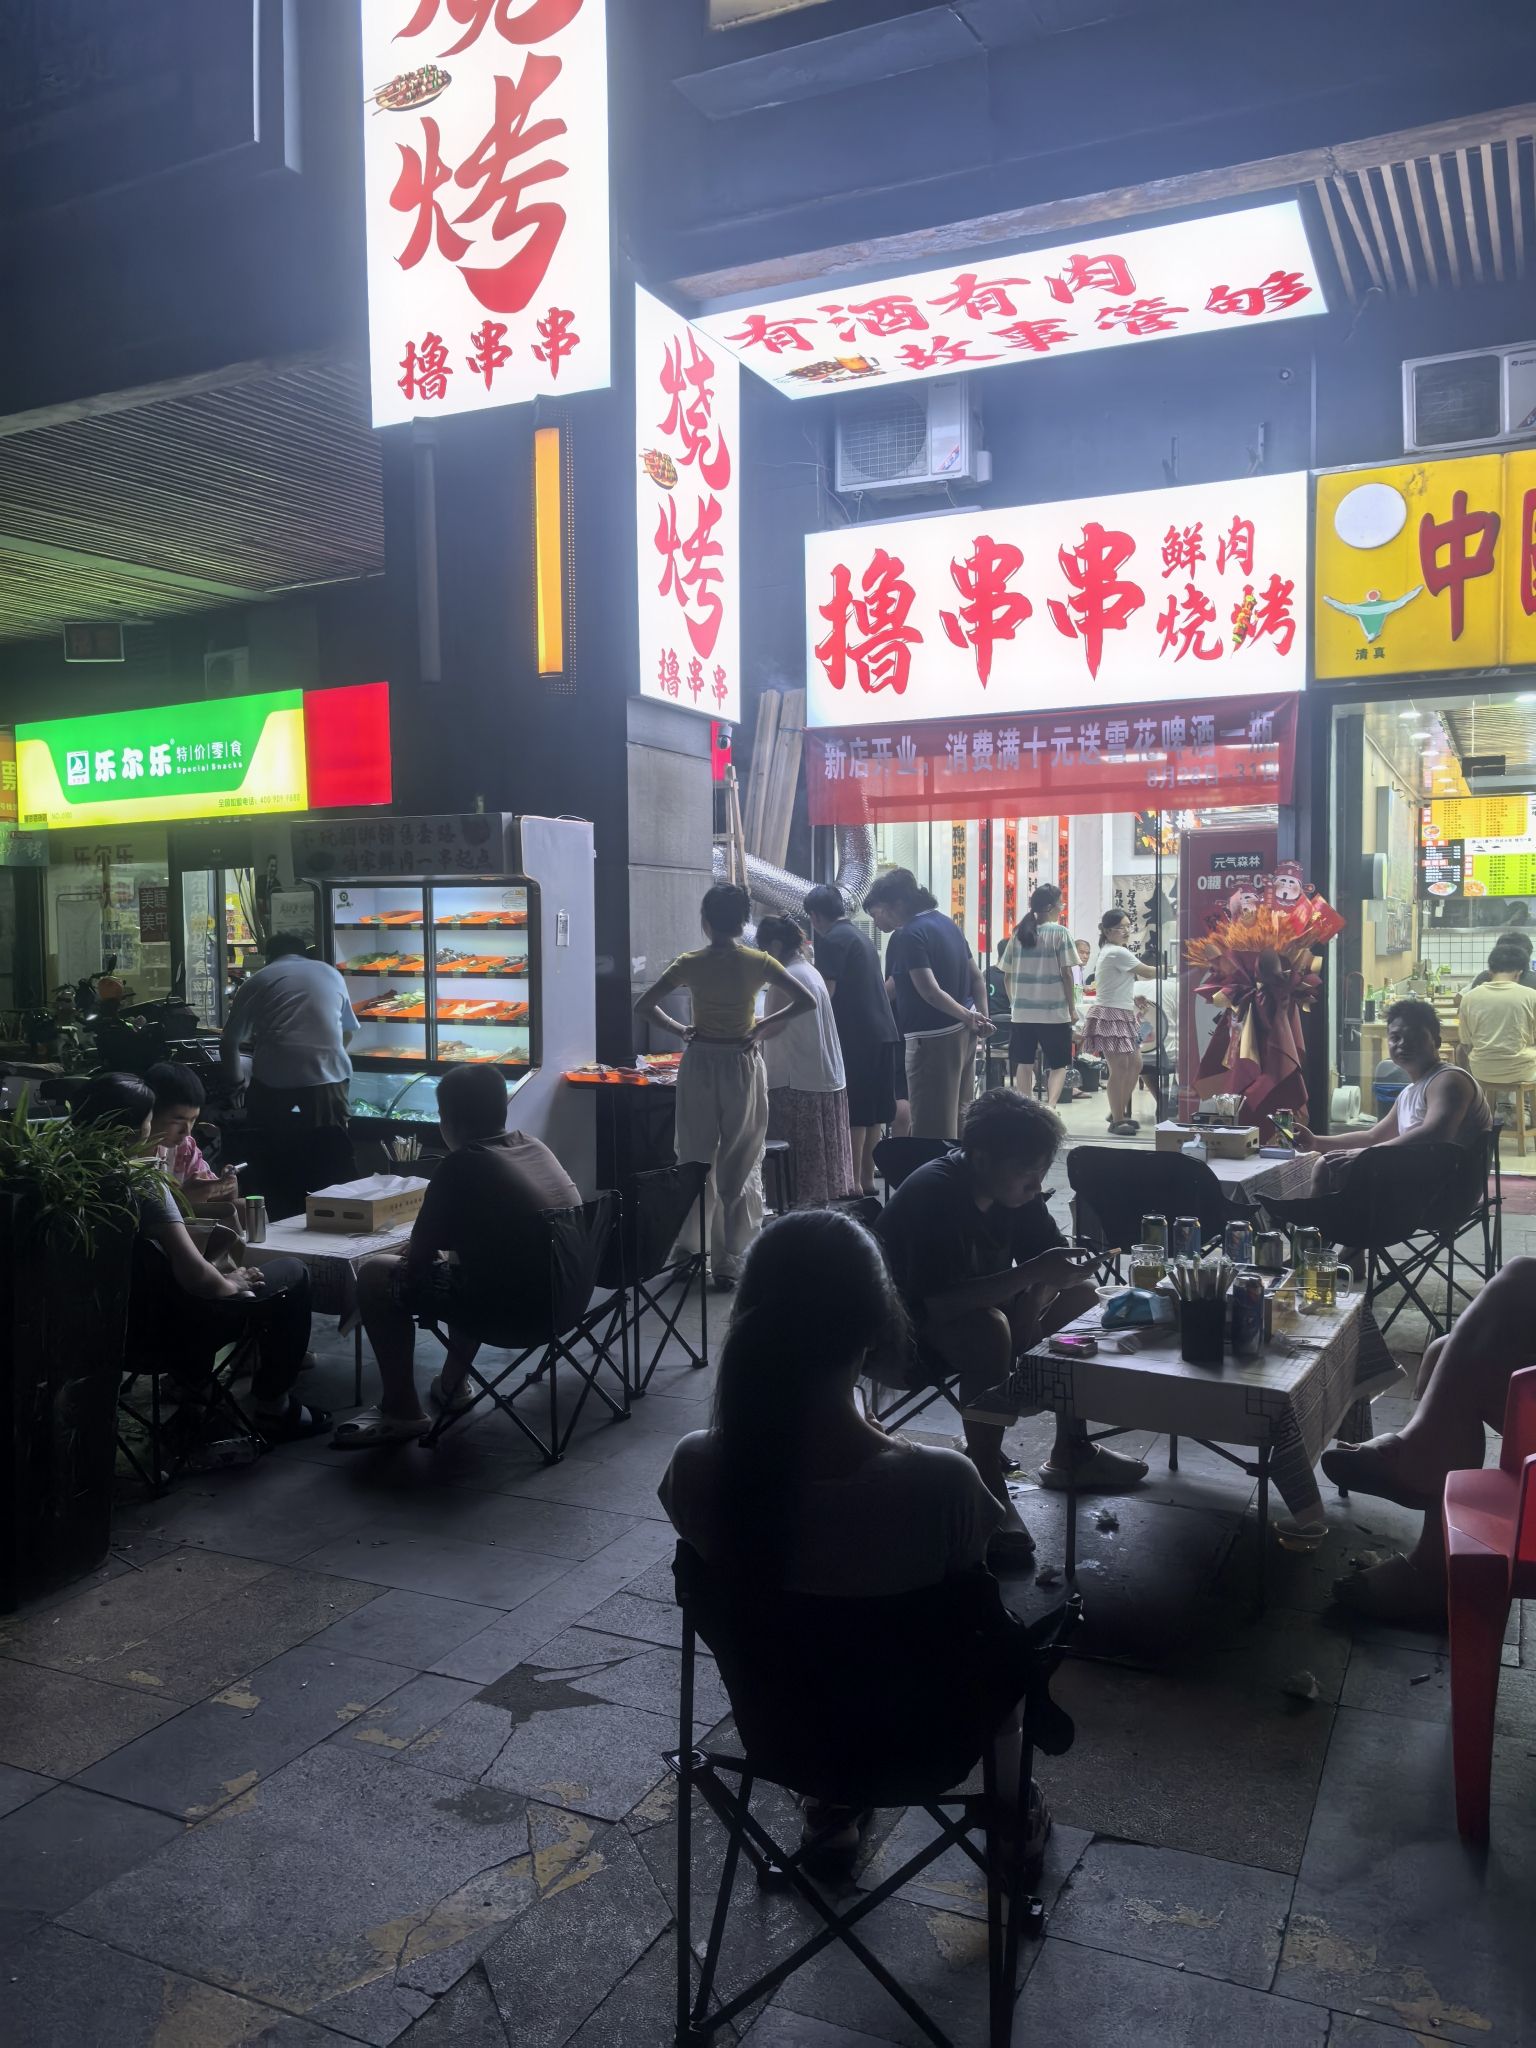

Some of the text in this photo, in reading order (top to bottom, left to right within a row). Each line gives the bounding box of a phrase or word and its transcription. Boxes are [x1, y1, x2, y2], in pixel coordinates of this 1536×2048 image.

[390, 0, 585, 313] 烤
[724, 253, 1138, 354] 有酒有肉
[893, 270, 1314, 371] 故事管够
[398, 307, 580, 401] 撸串串
[654, 325, 731, 659] 烧烤
[1161, 515, 1256, 580] 鲜肉
[815, 521, 1147, 695] 撸串串
[1156, 573, 1297, 664] 烧烤
[1355, 646, 1385, 661] 清真
[658, 647, 729, 711] 撸串串
[95, 743, 172, 783] 乐尔乐
[1214, 855, 1261, 869] 元气森林
